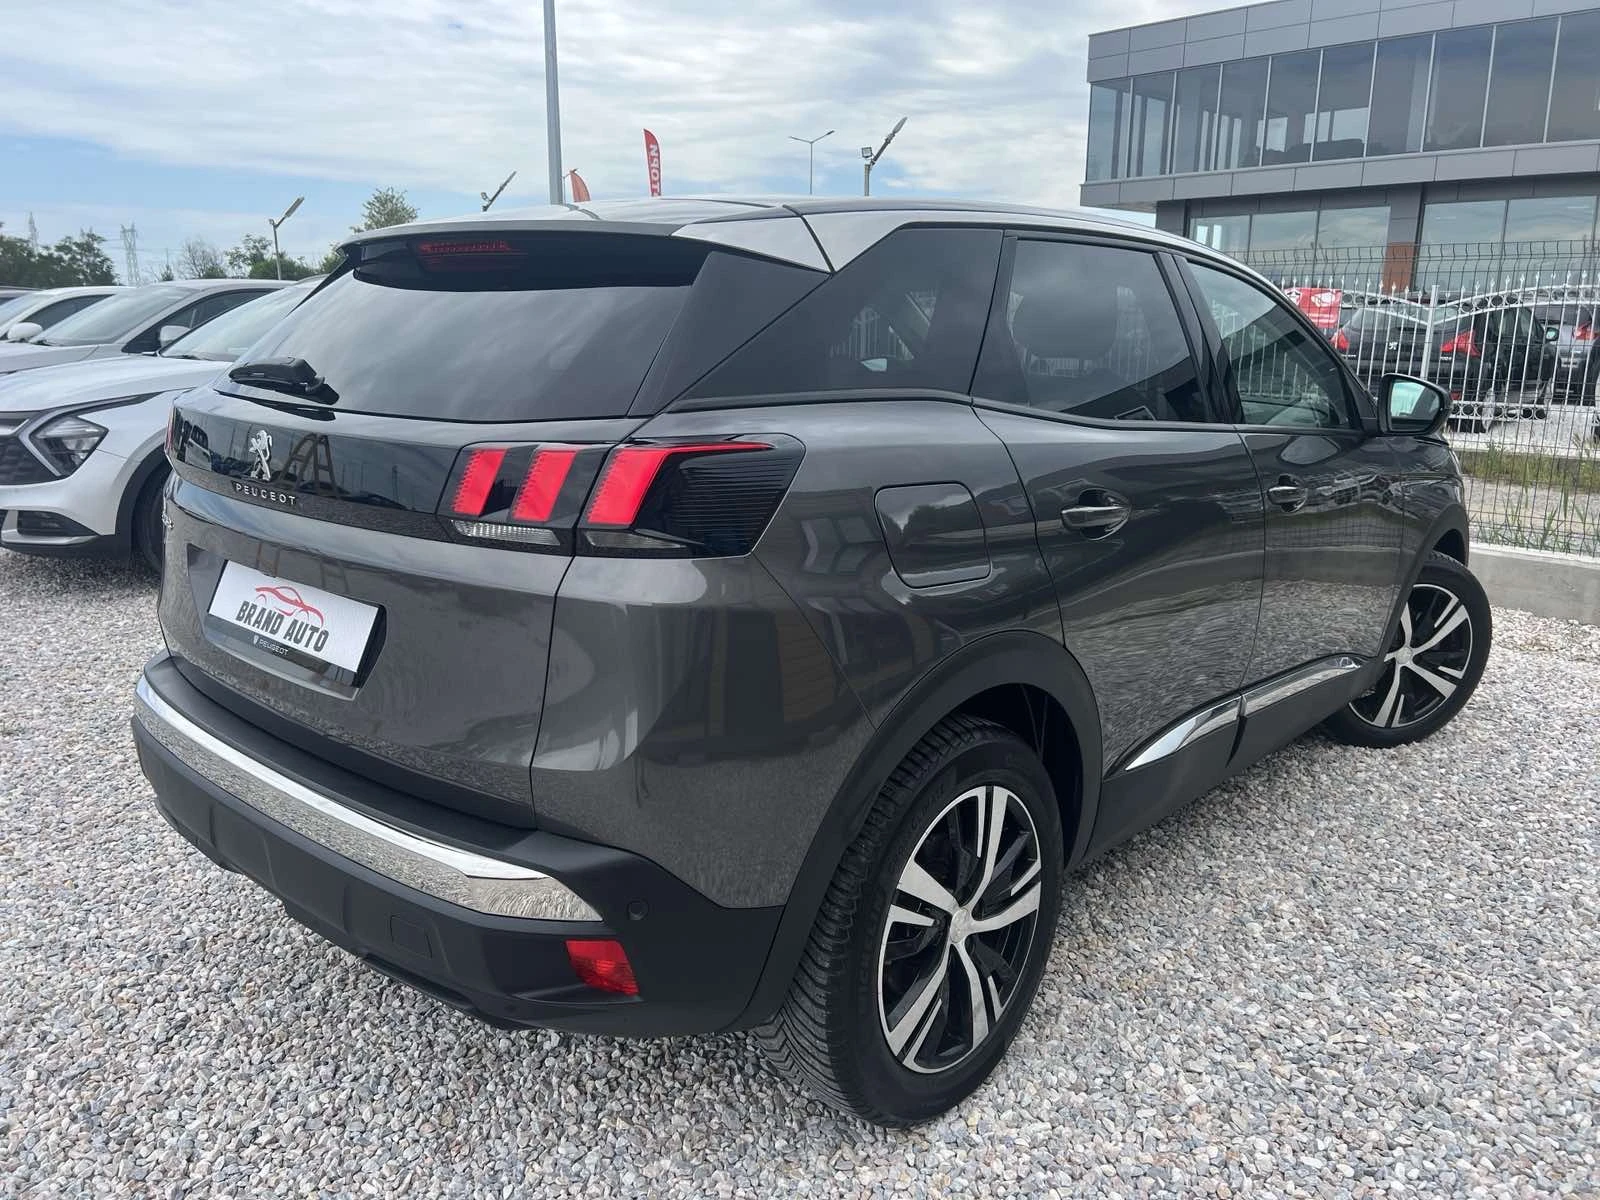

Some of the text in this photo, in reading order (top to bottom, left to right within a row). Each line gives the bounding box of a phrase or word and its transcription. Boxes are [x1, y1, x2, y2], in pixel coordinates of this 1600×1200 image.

[235, 482, 296, 505] PEUGEOT
[235, 600, 330, 653] BRAND AUTO
[259, 637, 289, 656] PEUGEOT
